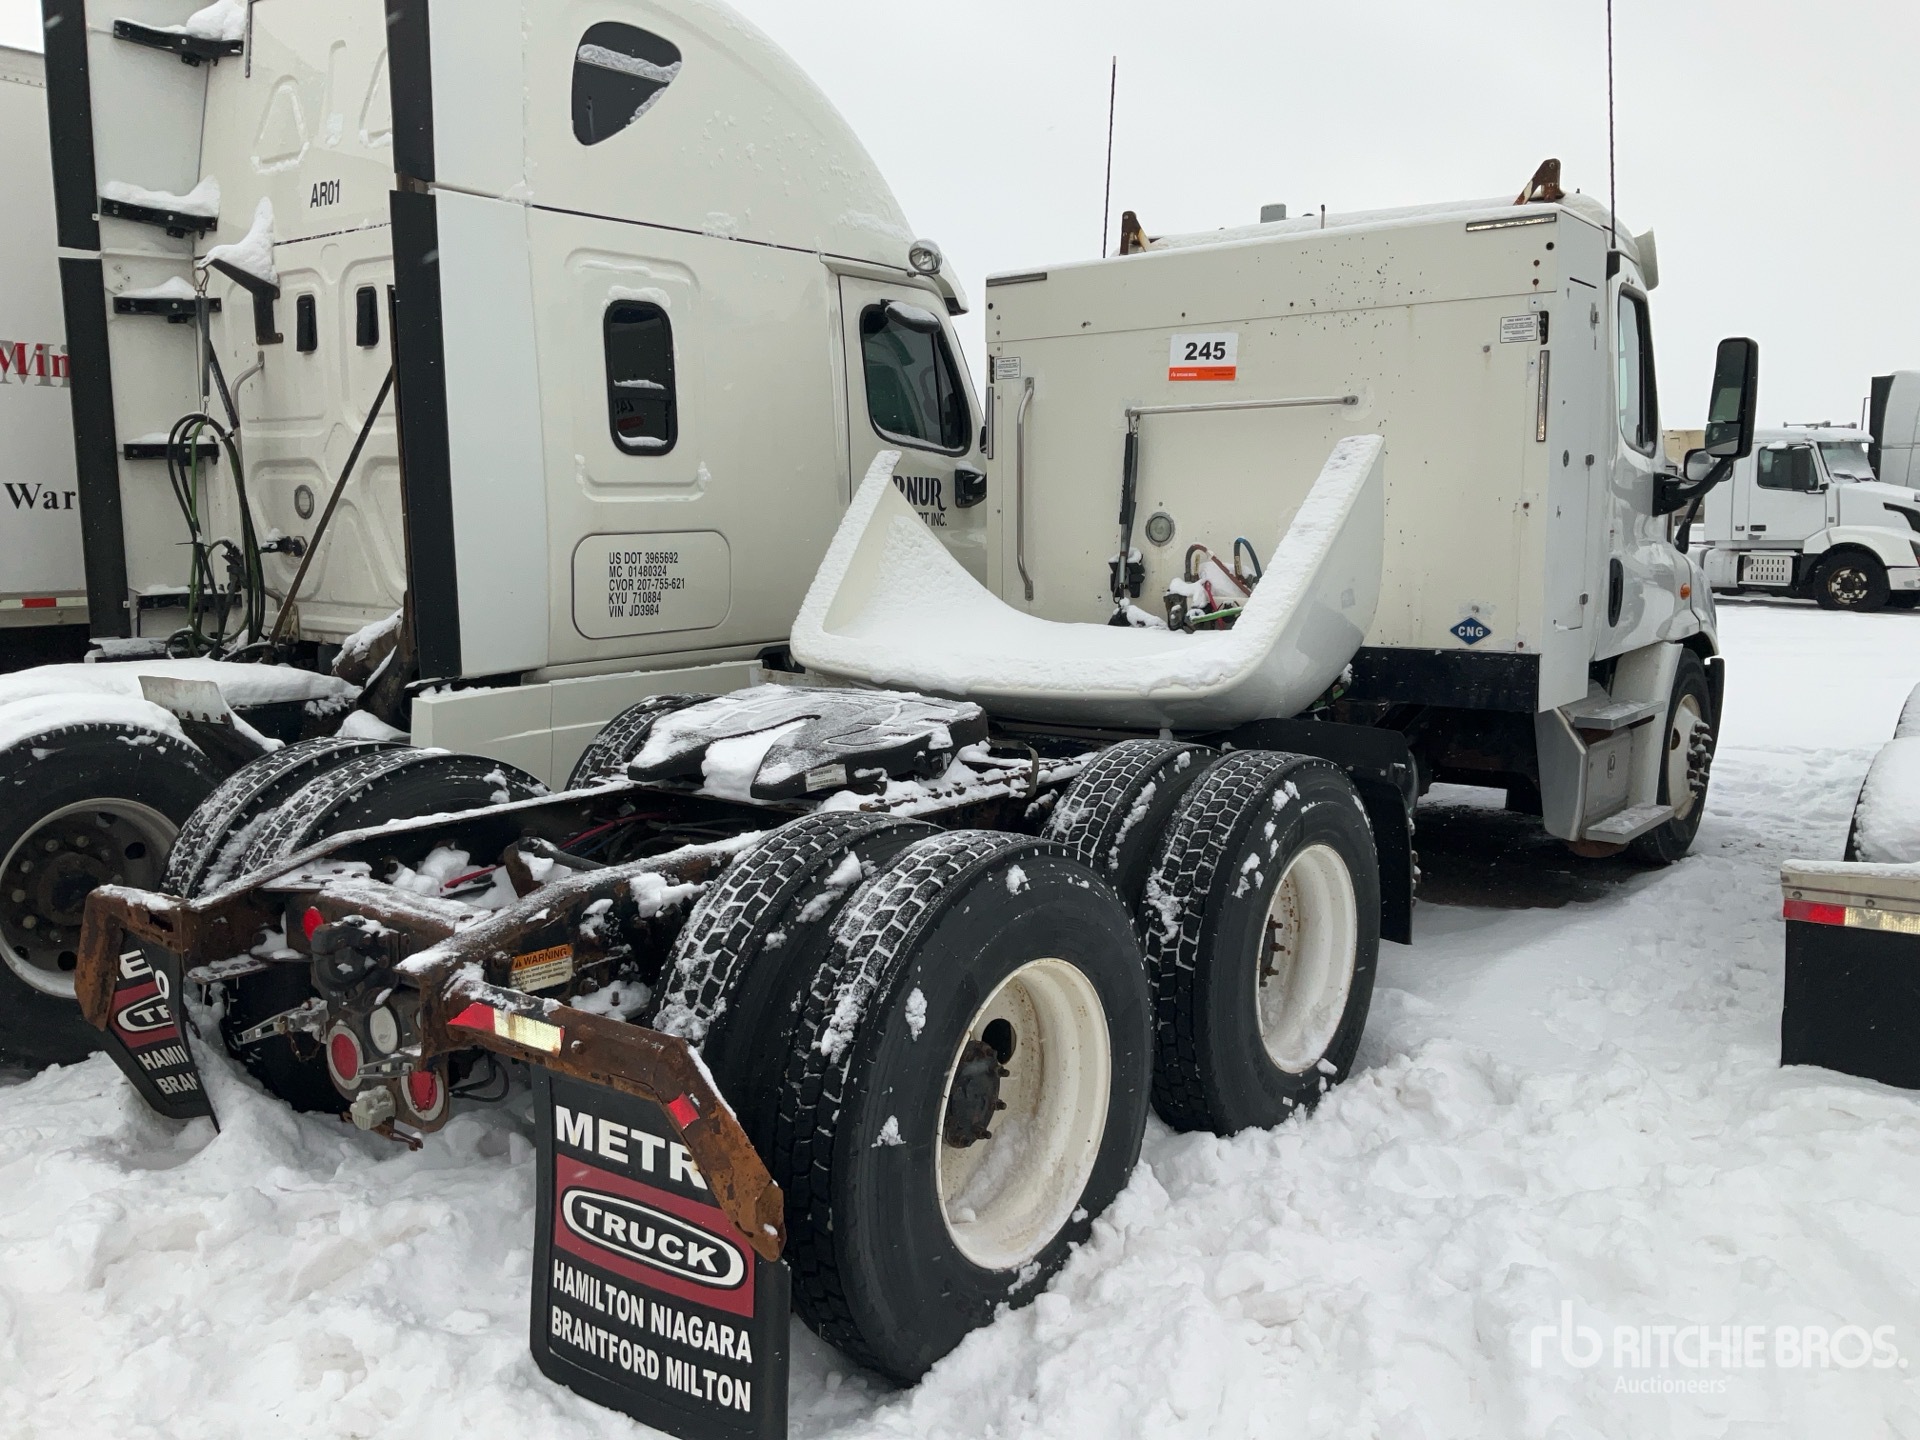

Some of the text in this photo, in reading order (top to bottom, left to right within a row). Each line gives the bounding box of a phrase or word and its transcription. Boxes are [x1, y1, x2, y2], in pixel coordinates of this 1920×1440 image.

[310, 179, 340, 208] AR01
[1184, 341, 1226, 361] 245
[4, 483, 76, 510] War
[931, 512, 947, 527] INC.
[609, 551, 678, 565] US DOT 3965692
[609, 565, 667, 578] MC 01480324
[609, 578, 685, 591] CVOR 207-755-621
[609, 591, 662, 604] KYU 710884
[609, 604, 659, 617] VIN JD3984
[1458, 626, 1484, 637] CNG
[523, 948, 567, 966] WARNING
[581, 1202, 718, 1273] TRUCK
[553, 1259, 753, 1363] HAMILTON NIAGARA
[552, 1305, 751, 1412] BRANTFORD MILTON
